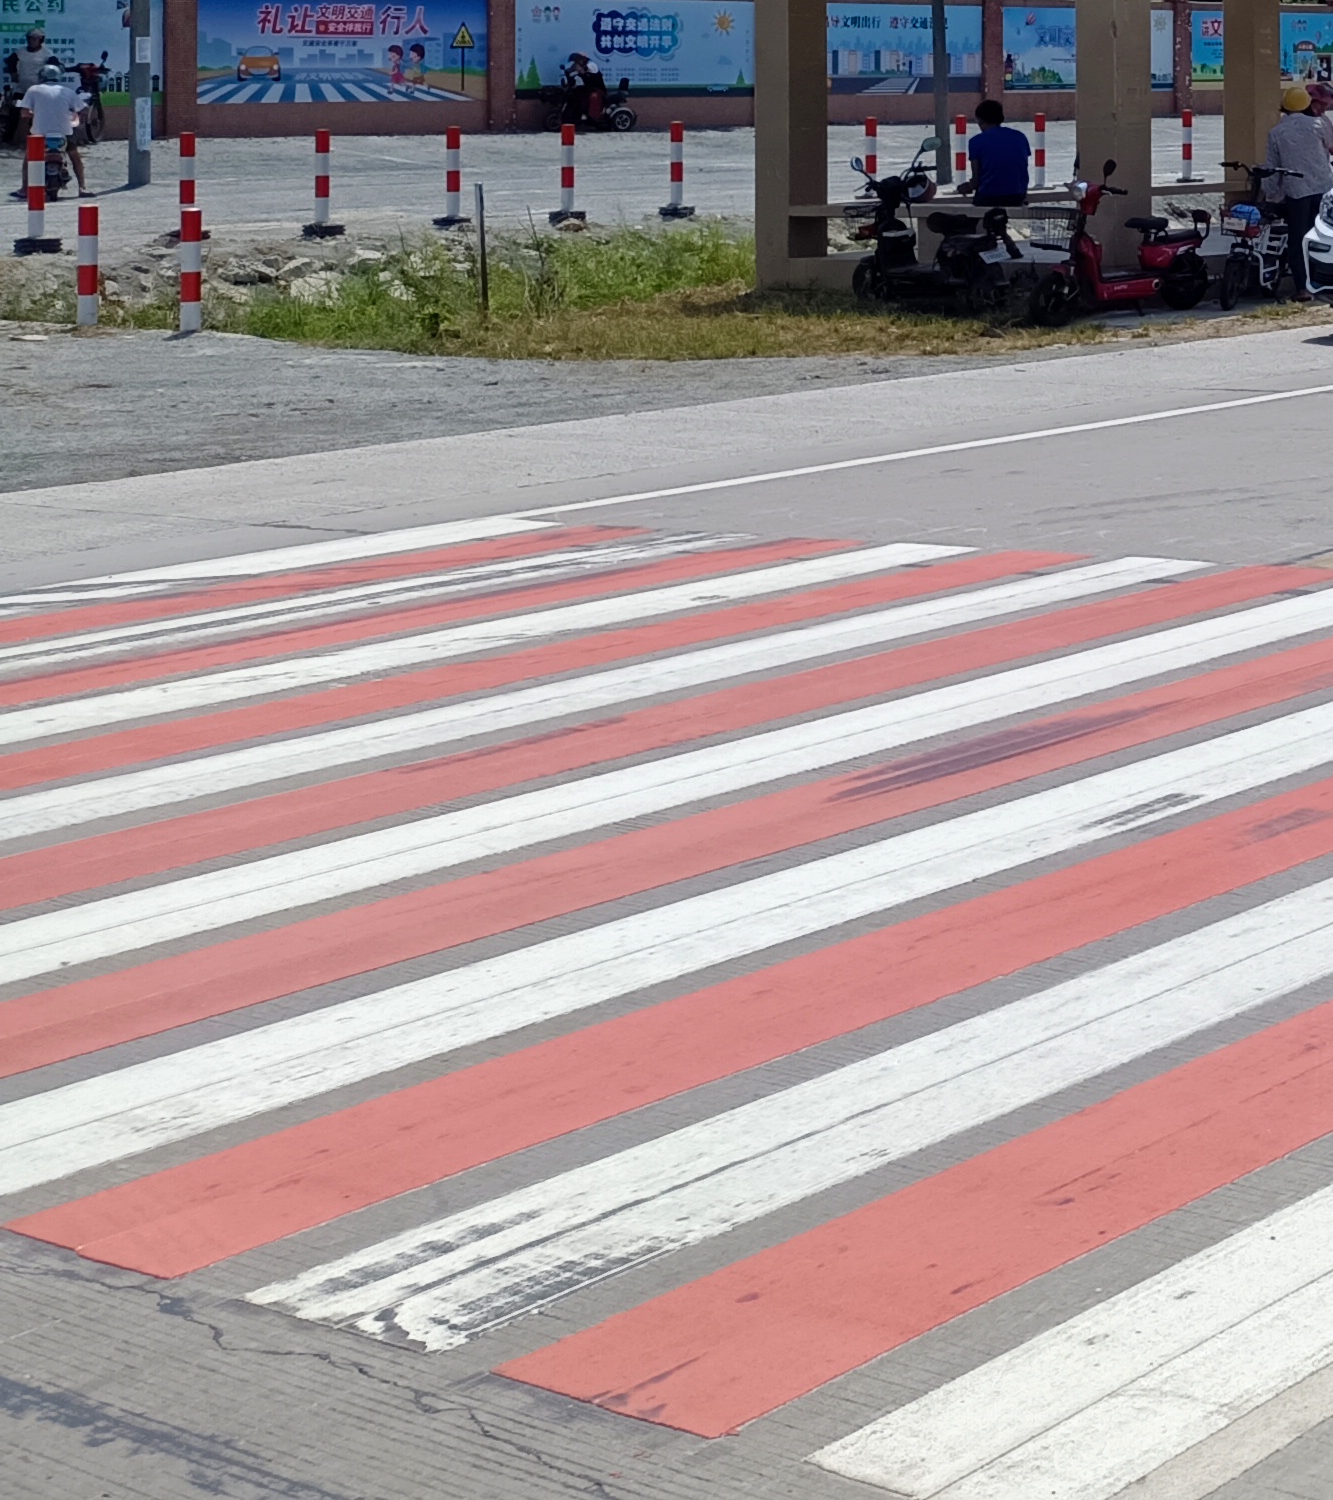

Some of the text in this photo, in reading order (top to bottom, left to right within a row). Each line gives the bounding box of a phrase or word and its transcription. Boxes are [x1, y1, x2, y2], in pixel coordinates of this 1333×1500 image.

[257, 4, 430, 36] 礼让 行人
[316, 5, 375, 20] 文明交通
[600, 17, 673, 32] 遵守交通法则
[827, 15, 948, 30] 导文明出行 遵守交通
[600, 35, 673, 49] 共创文明开平
